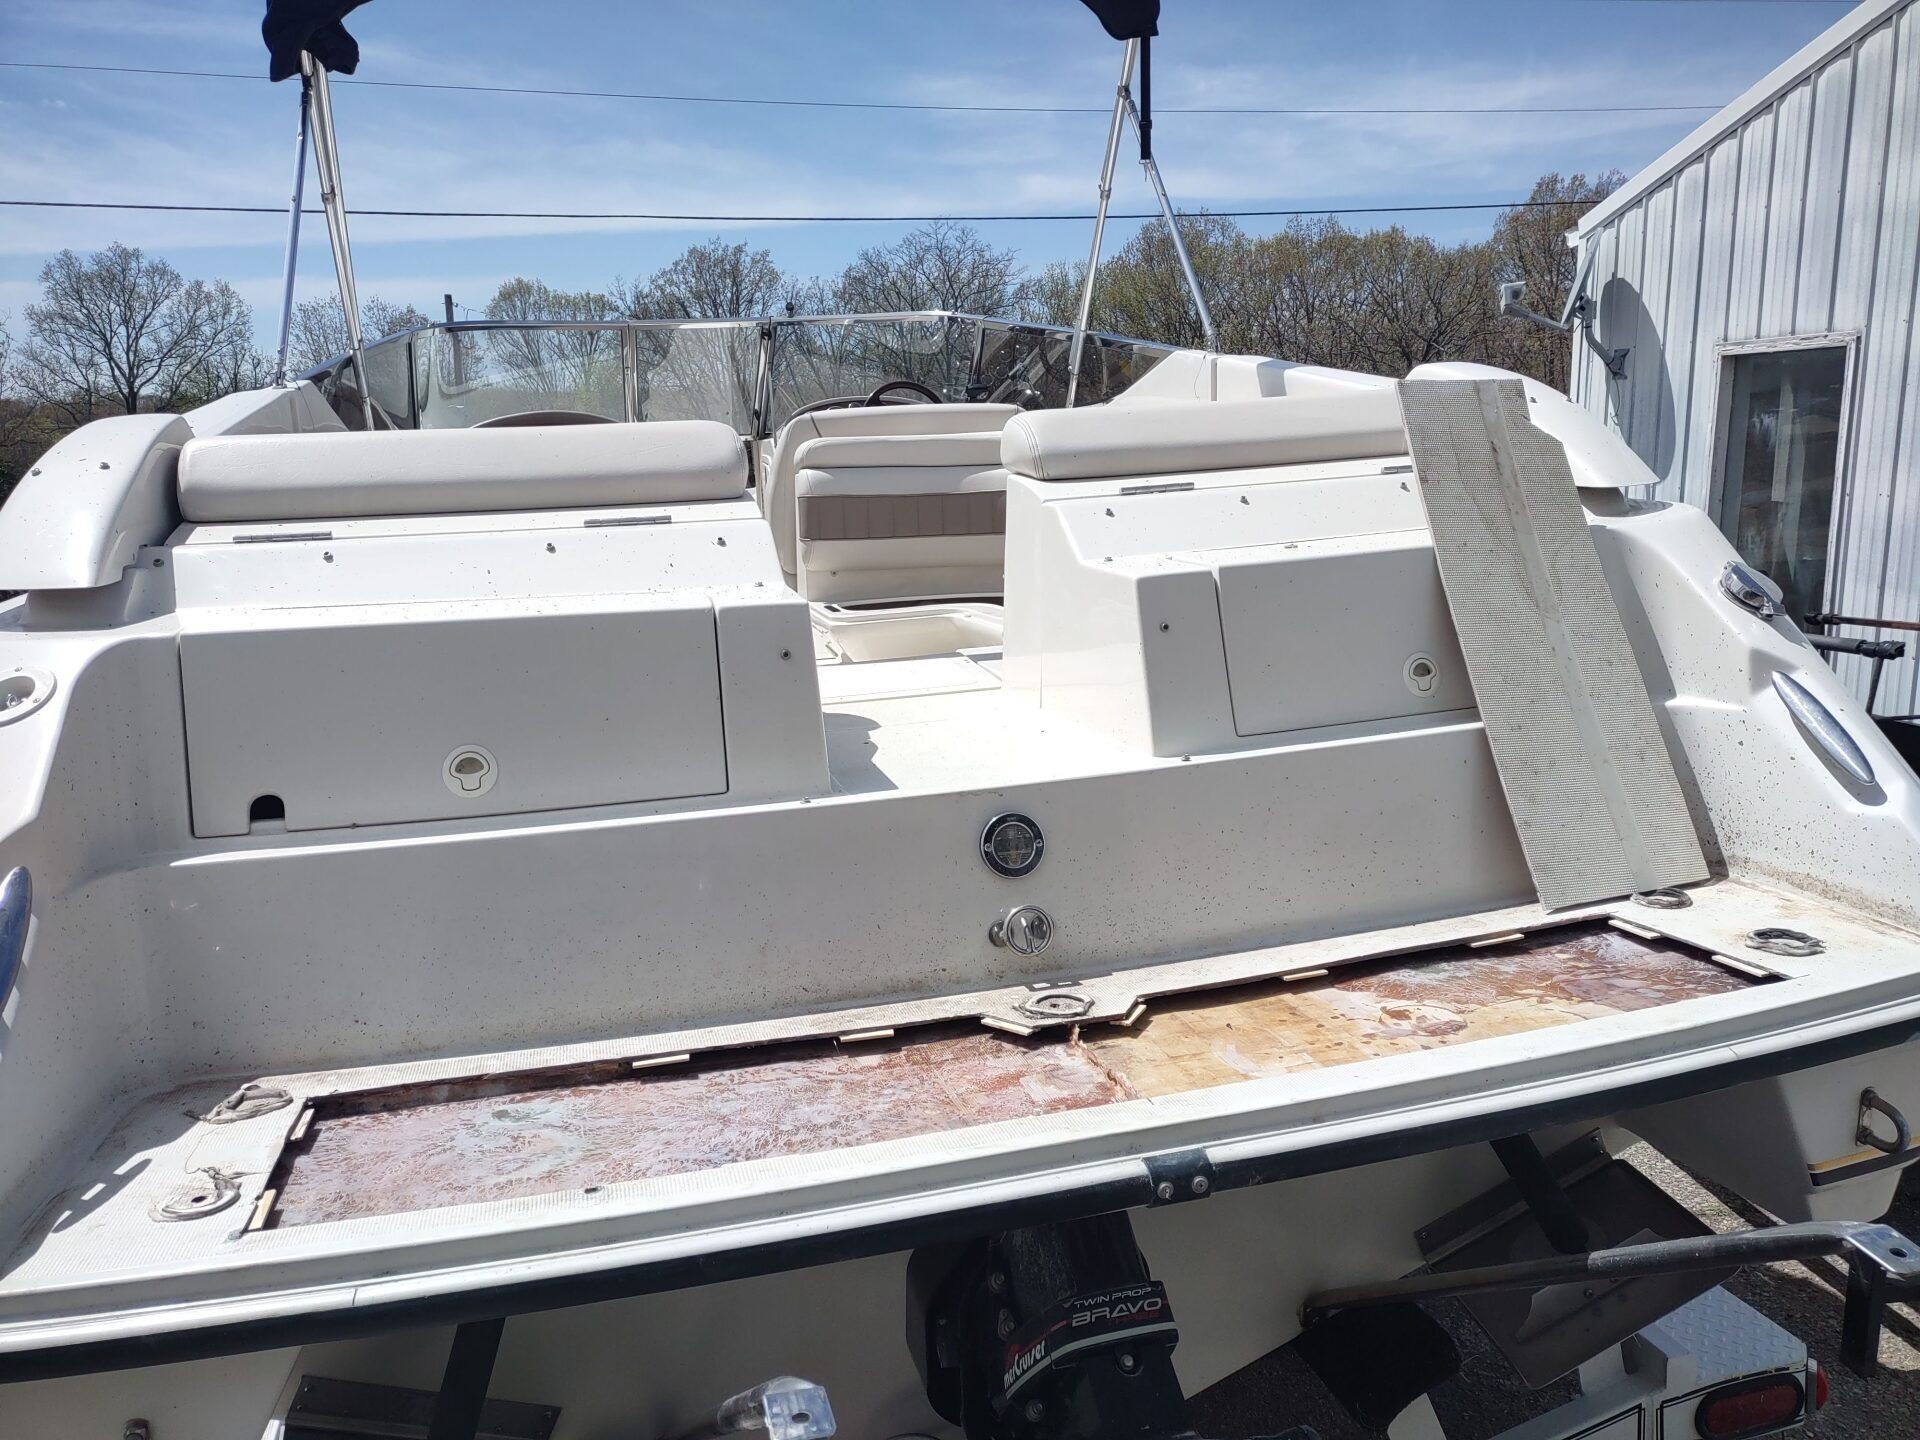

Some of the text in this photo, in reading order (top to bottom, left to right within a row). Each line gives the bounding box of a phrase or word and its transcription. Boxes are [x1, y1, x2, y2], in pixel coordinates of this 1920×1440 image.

[1074, 1287, 1152, 1309] TWIN PROP
[1072, 1297, 1162, 1328] BRAVO
